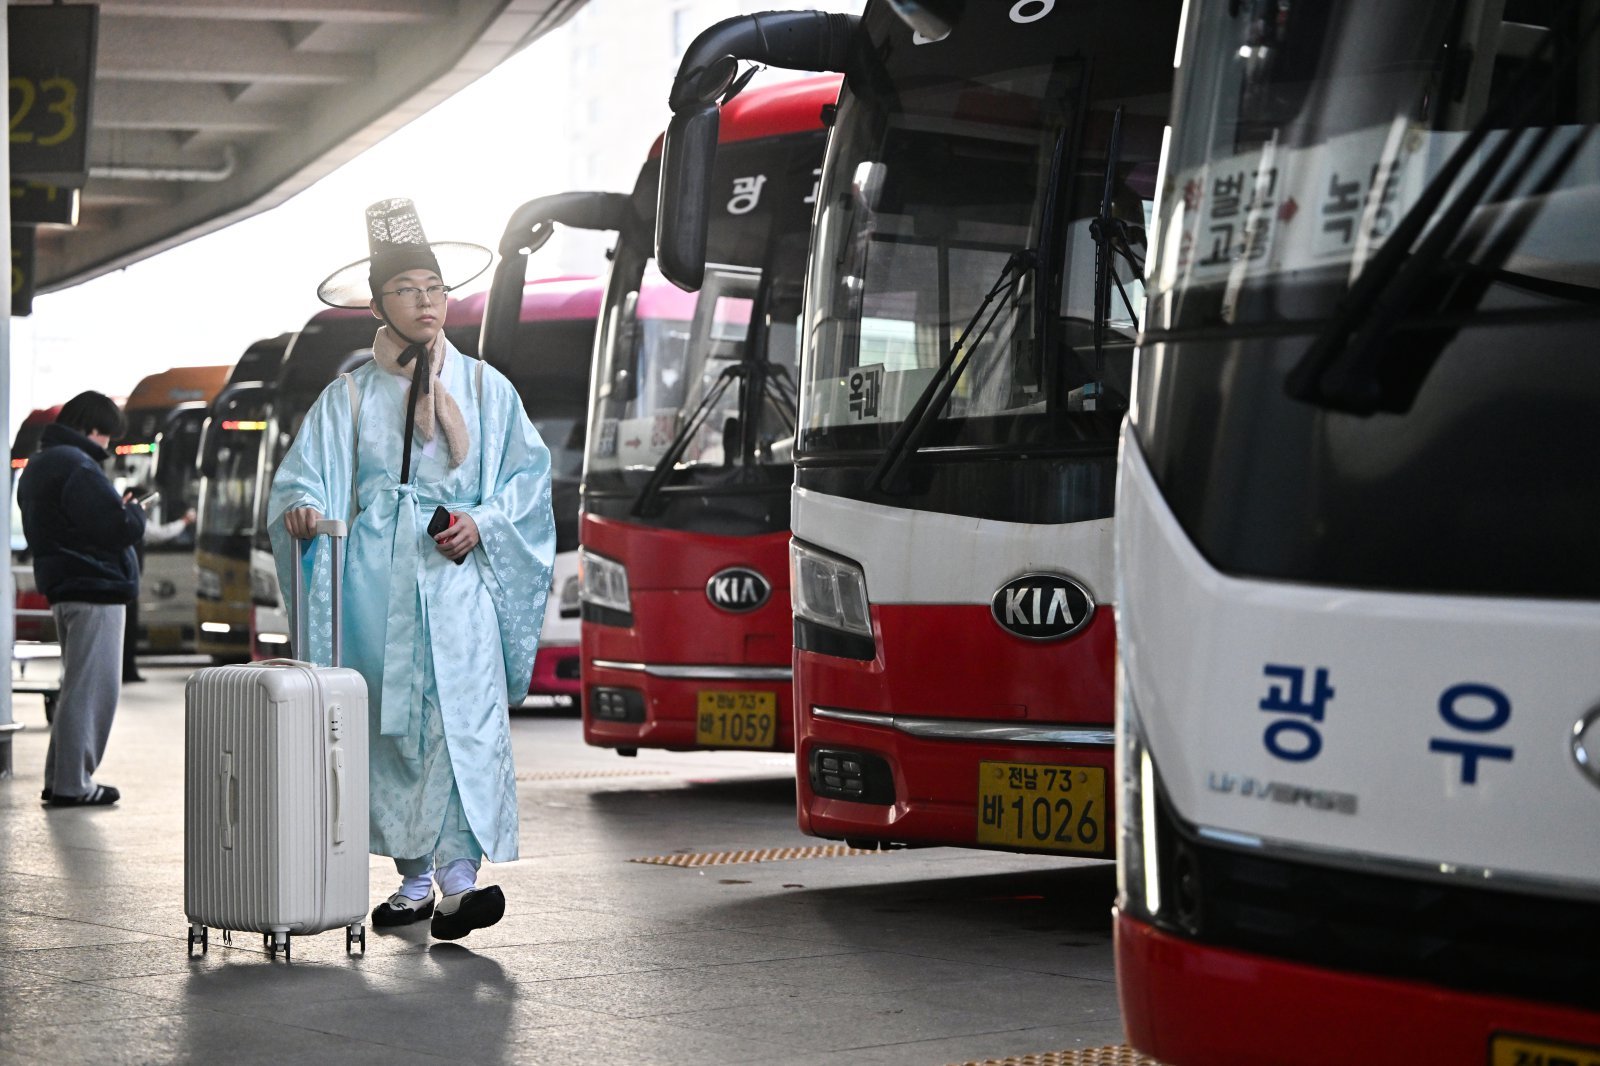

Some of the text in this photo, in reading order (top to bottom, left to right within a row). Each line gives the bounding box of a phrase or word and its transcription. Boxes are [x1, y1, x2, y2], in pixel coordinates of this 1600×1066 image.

[8, 76, 78, 146] 23
[715, 577, 757, 602] KIA
[1005, 587, 1075, 625] KIA
